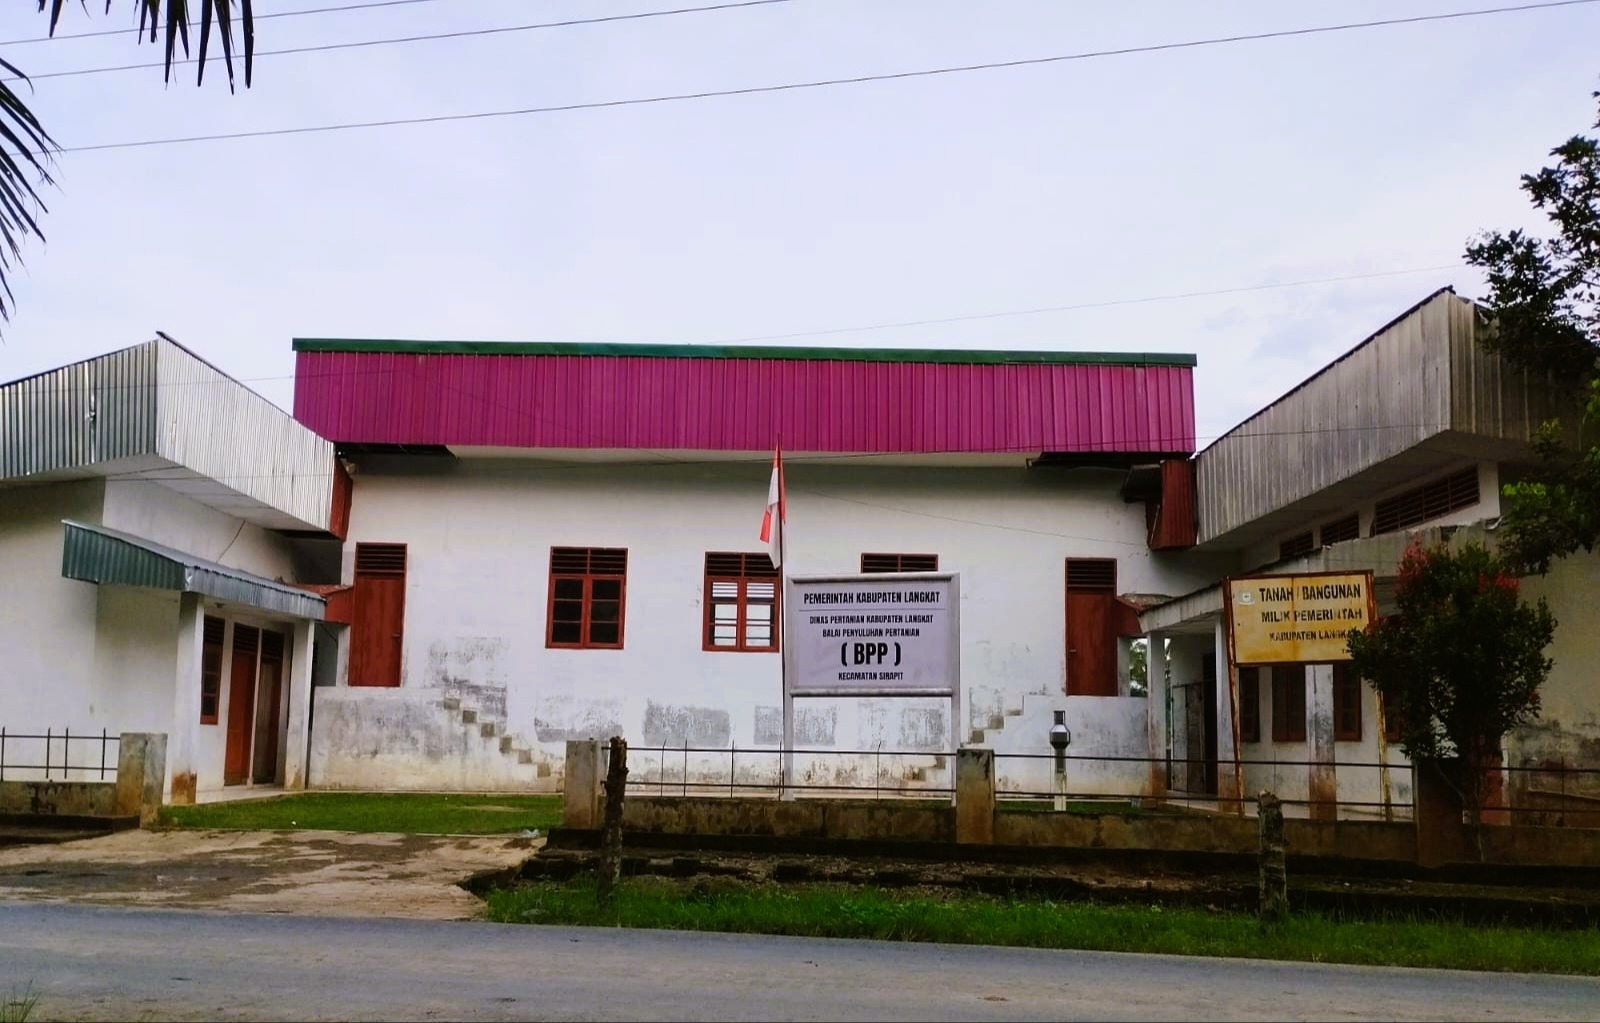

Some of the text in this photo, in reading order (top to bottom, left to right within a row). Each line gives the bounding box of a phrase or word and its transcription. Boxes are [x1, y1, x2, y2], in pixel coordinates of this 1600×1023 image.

[804, 591, 940, 604] PEMERINTAH KABUPATEN LANGKAT
[1259, 587, 1294, 602] TANAH
[1302, 584, 1361, 600] BANGUNAN
[809, 614, 933, 624] DINAS PERTANIAN KABUPATEN LANGKAT
[1261, 610, 1291, 623] MILIK
[822, 628, 920, 637] BALAI PENYULUHAN PERTANIAN
[1270, 631, 1317, 641] KABUPATEN
[838, 672, 903, 680] KECAMATAN SIRAPIT
